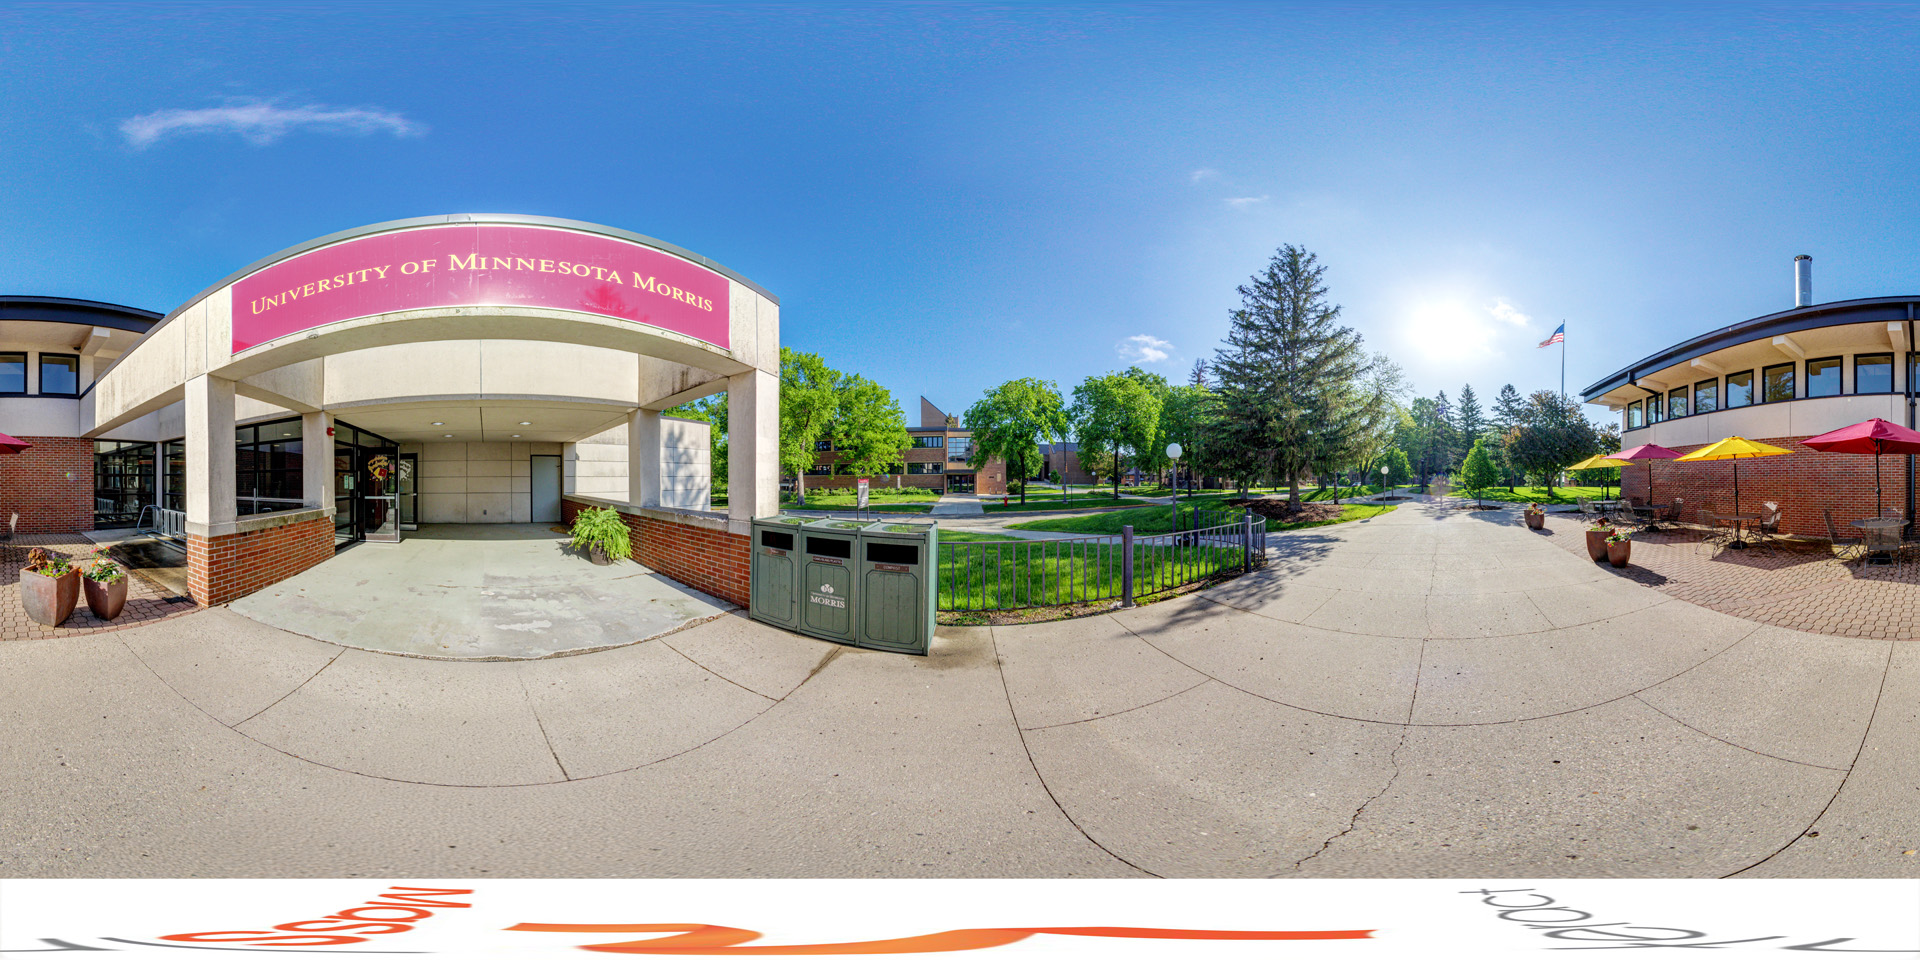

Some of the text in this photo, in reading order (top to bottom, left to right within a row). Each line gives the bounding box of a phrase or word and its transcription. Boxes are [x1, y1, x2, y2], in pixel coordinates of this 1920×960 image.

[251, 252, 714, 315] UNIVERSITY OF MINNESOTA MORRIS
[810, 595, 845, 609] MORRIS
